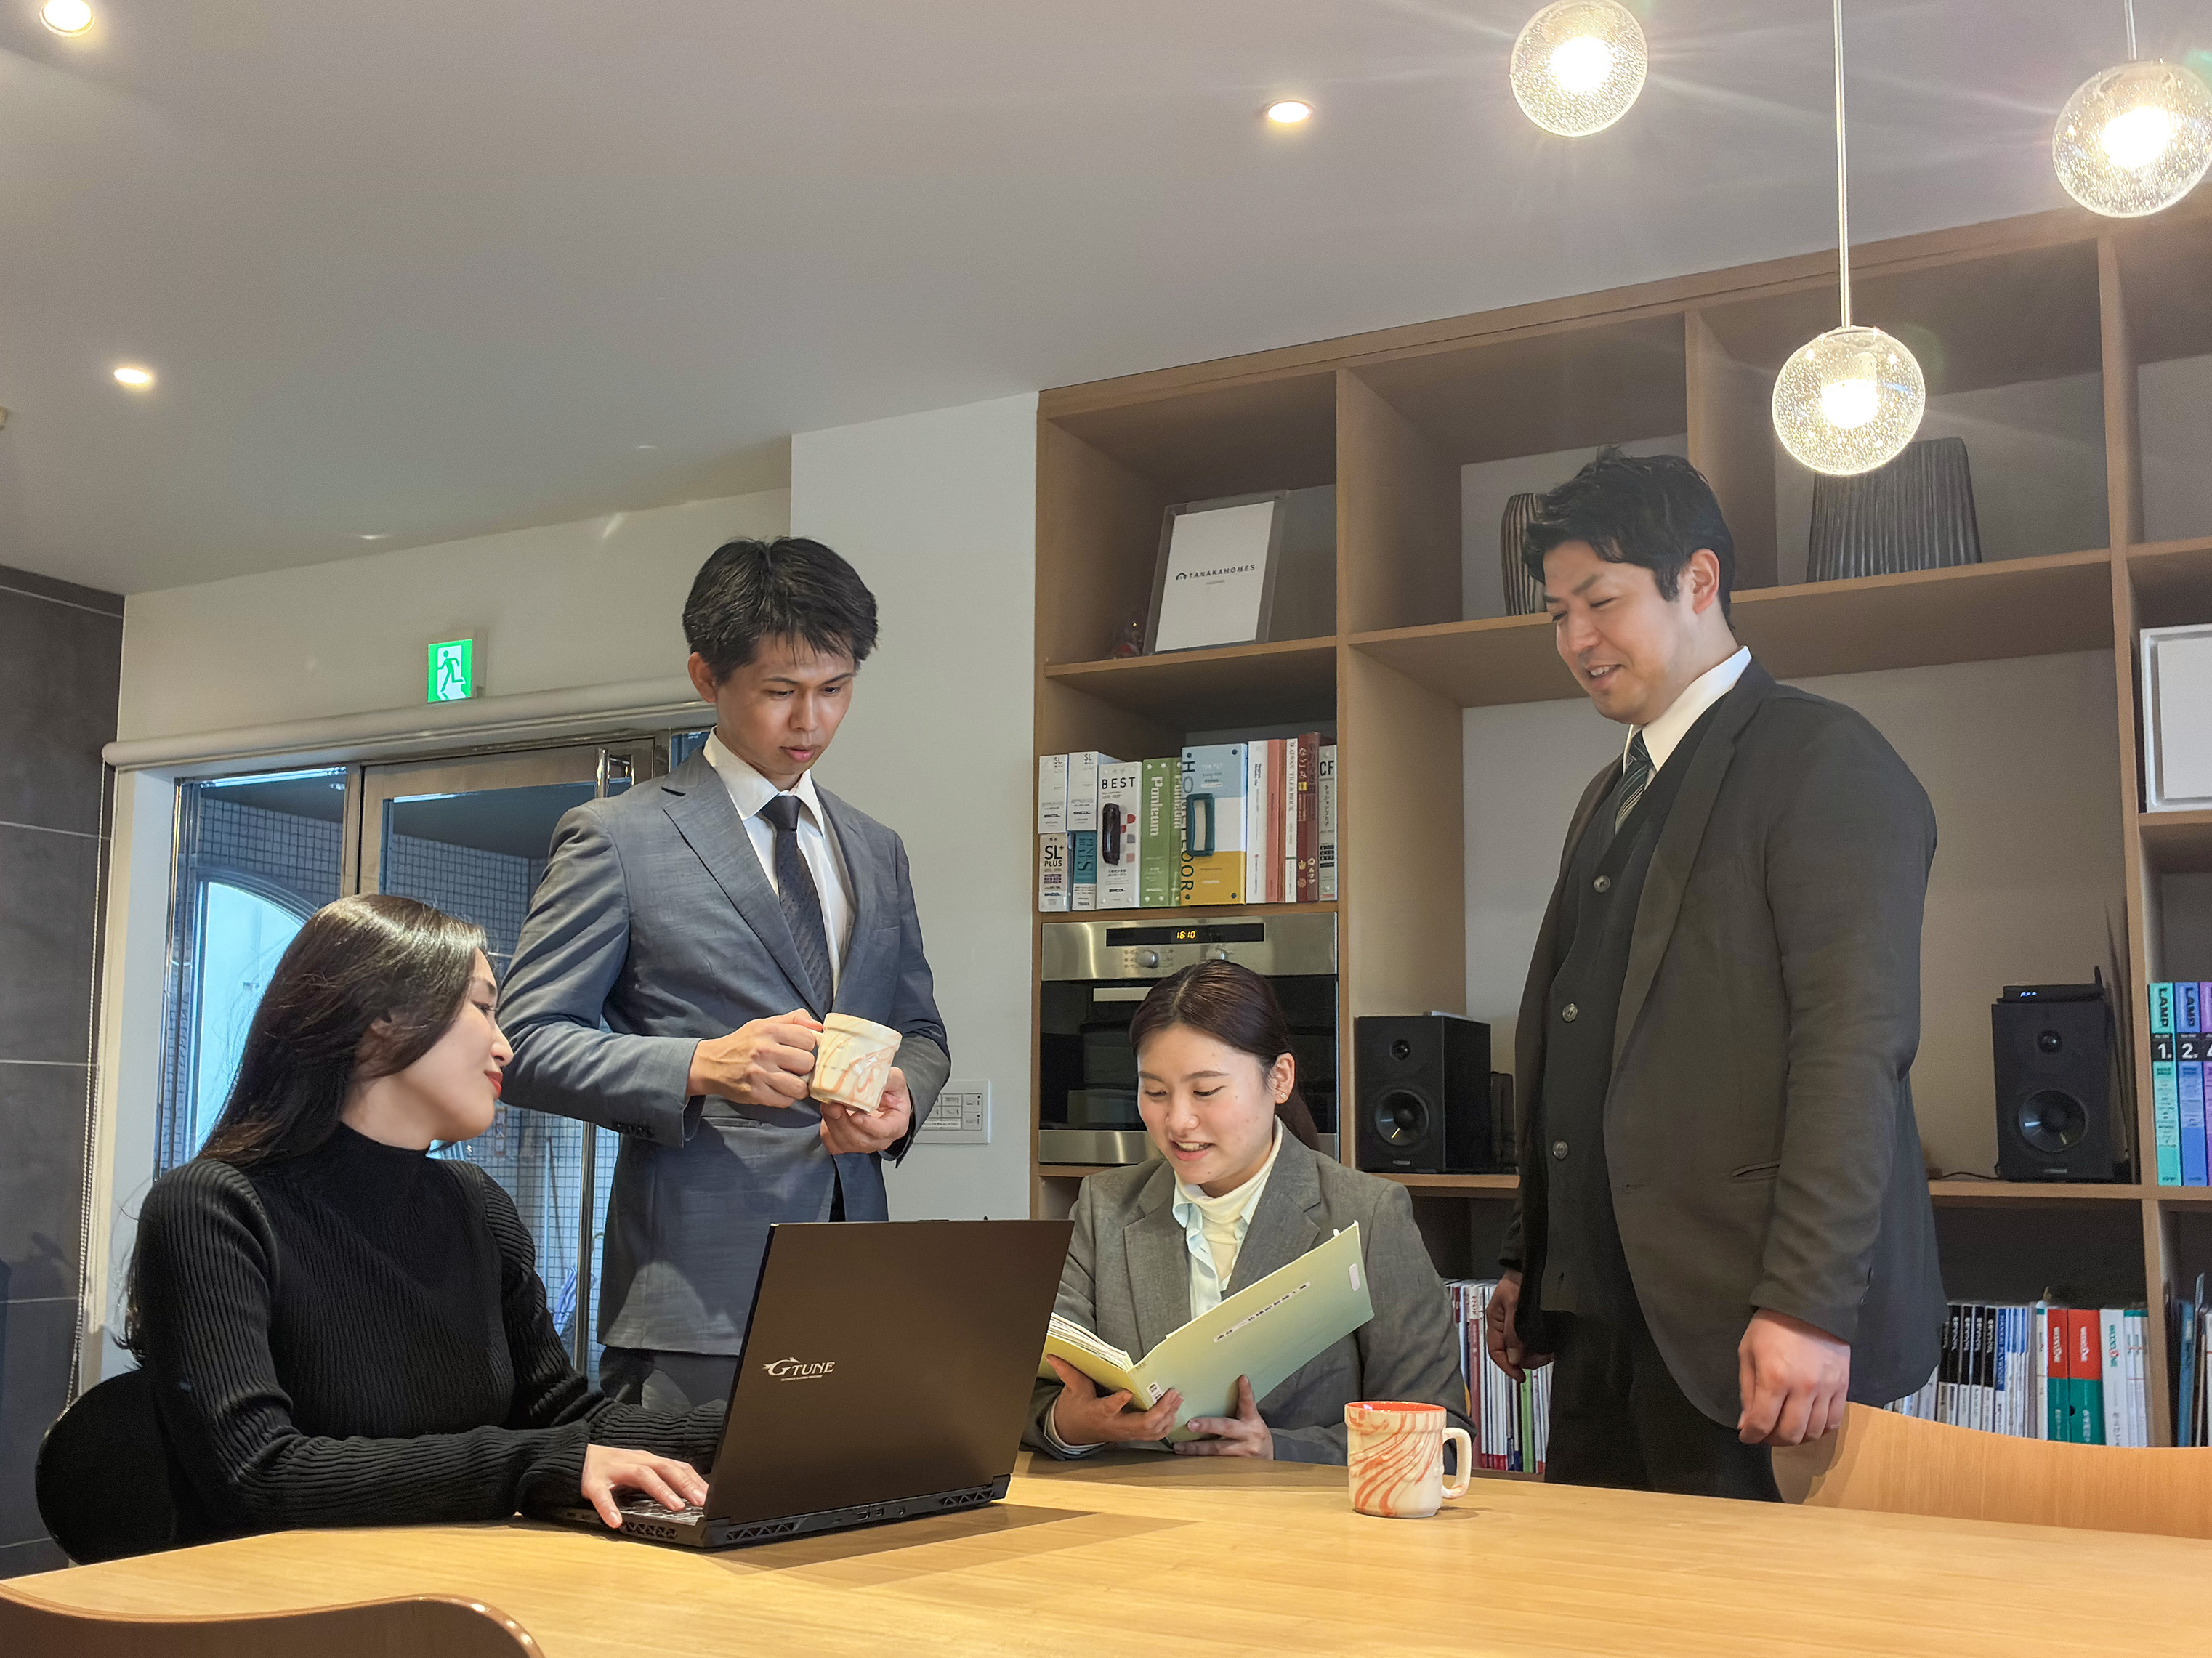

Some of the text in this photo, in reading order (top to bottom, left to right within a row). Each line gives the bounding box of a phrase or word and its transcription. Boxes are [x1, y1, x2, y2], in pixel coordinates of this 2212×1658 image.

[1189, 565, 1256, 578] TANAKAHOMES
[1320, 761, 1334, 776] CF
[1102, 777, 1136, 789] BEST
[2159, 987, 2168, 1027] LAMP
[2185, 987, 2195, 1027] LAMP
